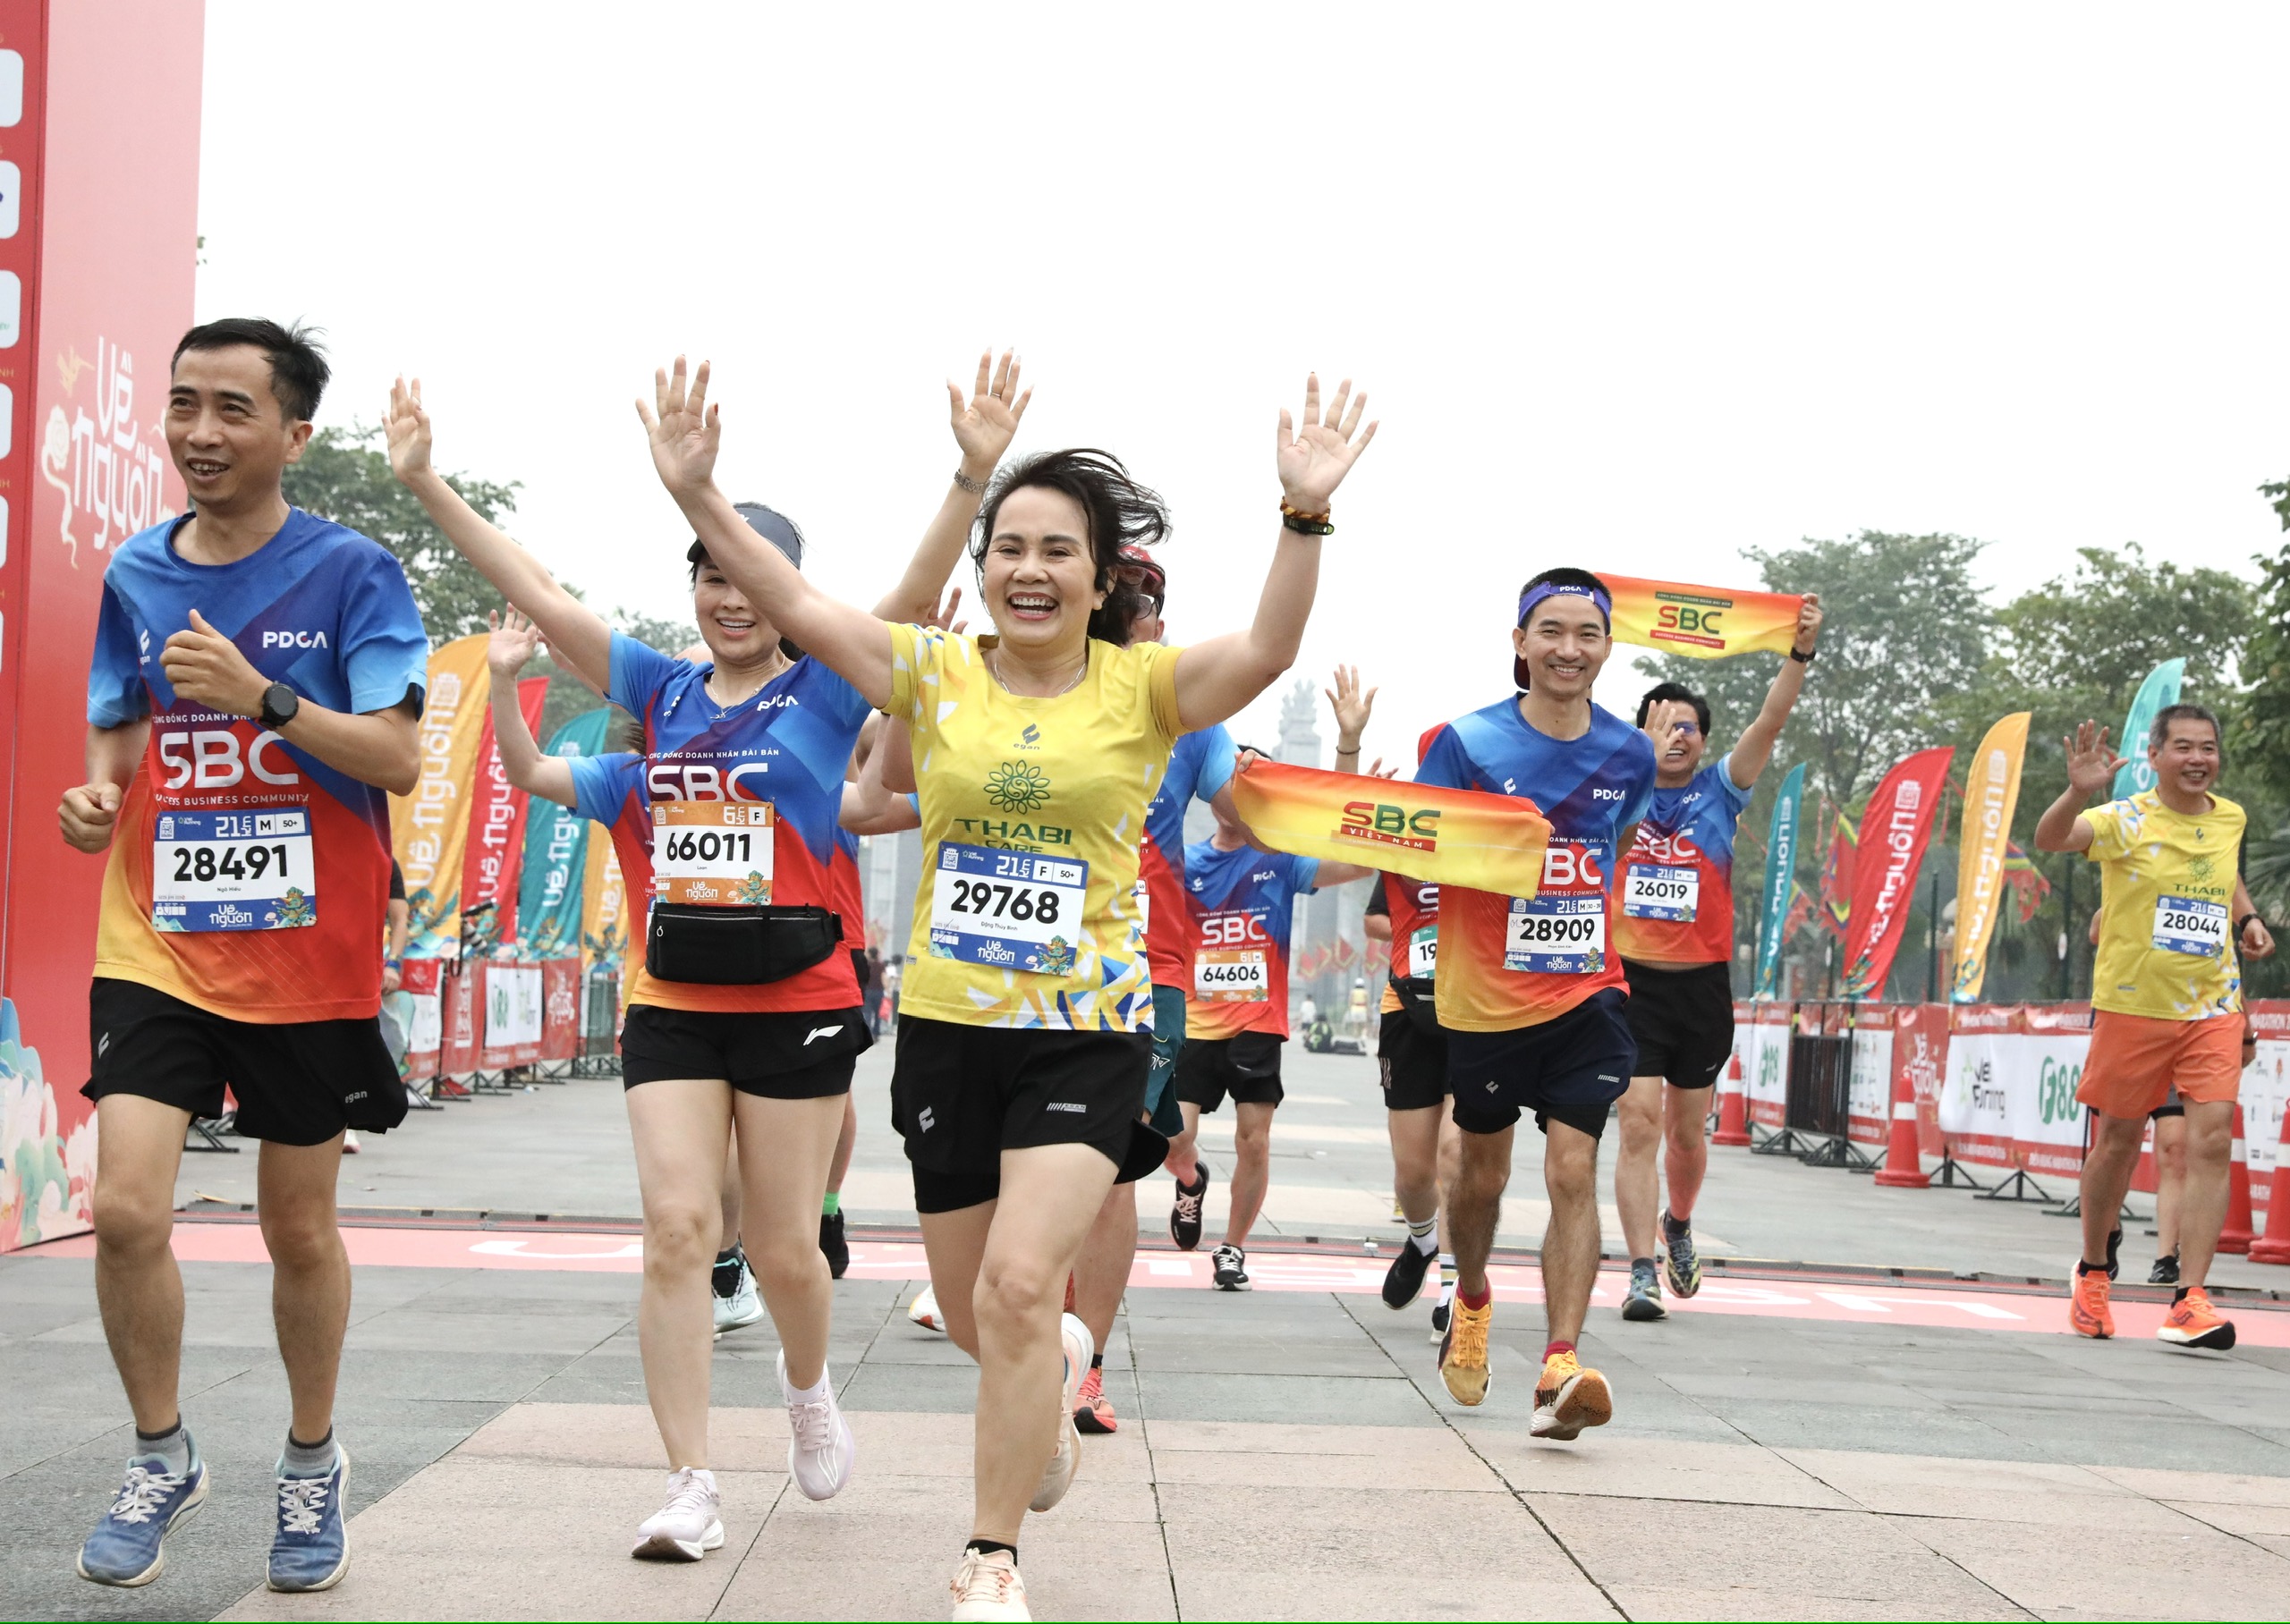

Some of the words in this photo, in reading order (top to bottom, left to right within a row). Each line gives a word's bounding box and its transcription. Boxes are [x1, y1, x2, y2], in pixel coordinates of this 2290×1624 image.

[1658, 605, 1722, 635] SBC
[263, 630, 327, 649] PDCA
[191, 714, 228, 723] DOANH
[717, 750, 739, 758] NHÂN
[742, 749, 758, 757] BÀI
[760, 747, 779, 756] BẢN
[1014, 742, 1039, 750] egan
[159, 730, 300, 790] SBC
[649, 763, 768, 802] SBC
[184, 795, 239, 806] BUSINESS
[1683, 792, 1701, 804] DCA
[259, 819, 271, 831] M
[283, 819, 298, 828] 50+
[754, 812, 760, 821] F
[1342, 801, 1441, 837] SBC
[216, 816, 241, 837] 21
[954, 818, 1072, 845] THABI
[666, 833, 751, 862] 66011
[1392, 837, 1422, 849] NAM
[1632, 828, 1696, 859] SBC
[174, 844, 288, 882] 28491
[997, 856, 1018, 876] 21
[1039, 866, 1047, 876] F
[1543, 848, 1603, 885] BC
[1060, 870, 1074, 878] 50+
[1635, 881, 1688, 899] 26019
[2173, 884, 2226, 896] THABI
[951, 879, 1059, 925] 29768
[1556, 901, 1571, 914] 21
[1201, 914, 1268, 945] SBC
[1520, 918, 1595, 942] 28909
[2163, 912, 2220, 935] 28044
[1420, 943, 1438, 961] 19
[1203, 966, 1260, 982] 64606
